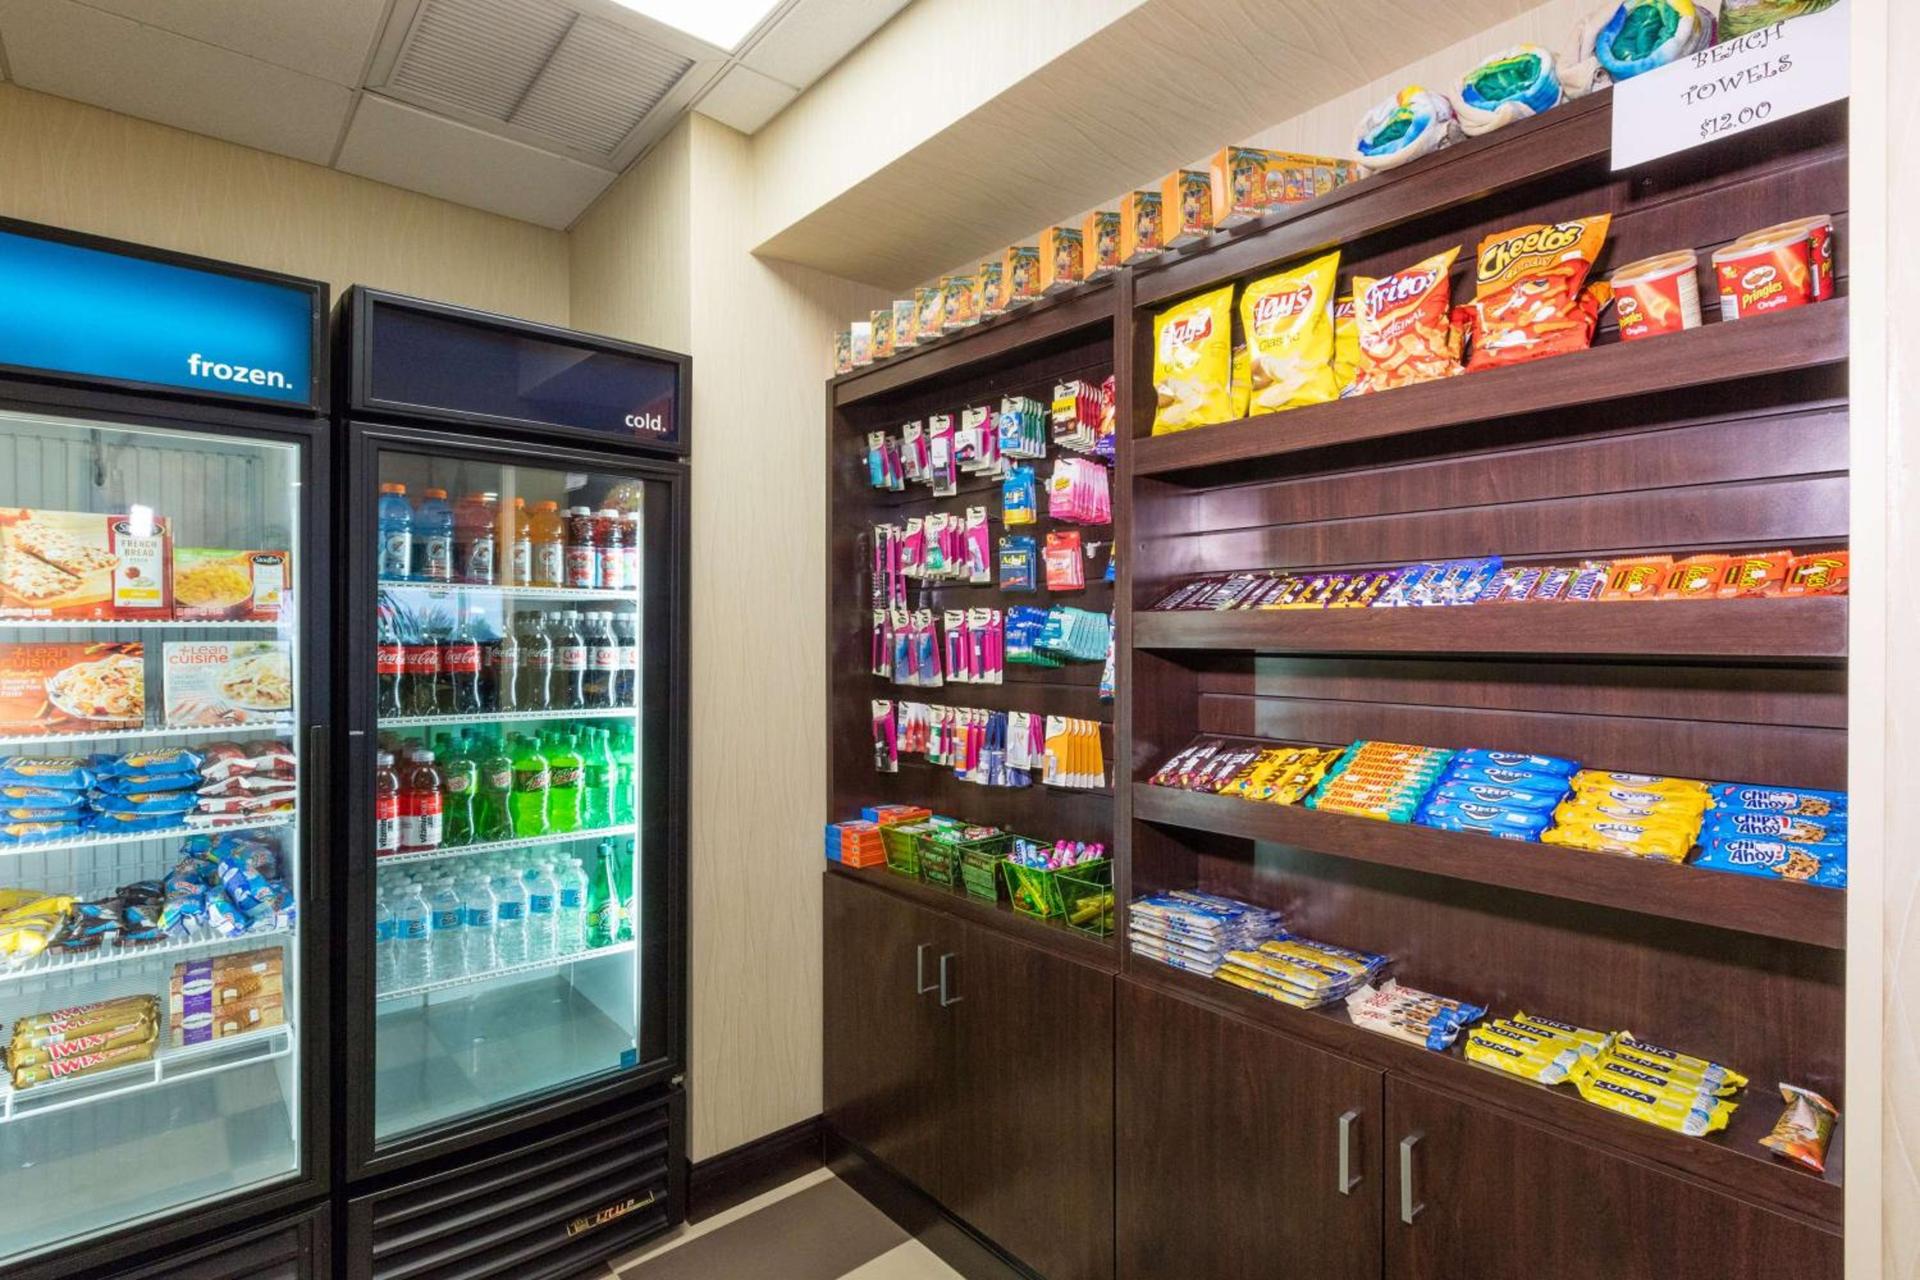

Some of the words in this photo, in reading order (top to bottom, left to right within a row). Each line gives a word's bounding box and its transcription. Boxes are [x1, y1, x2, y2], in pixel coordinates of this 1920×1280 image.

[1691, 20, 1785, 69] BEACH
[1681, 54, 1794, 105] TOWELS
[1700, 101, 1772, 138] $12.00
[1478, 225, 1583, 281] Cheetos
[1742, 280, 1784, 309] Pringles
[187, 353, 293, 389] frozen.
[625, 413, 667, 432] cold.
[169, 654, 230, 664] cuisine
[1506, 1020, 1551, 1037] LUNA
[1608, 1064, 1661, 1084] LUNA
[1596, 1080, 1650, 1101] LUNA
